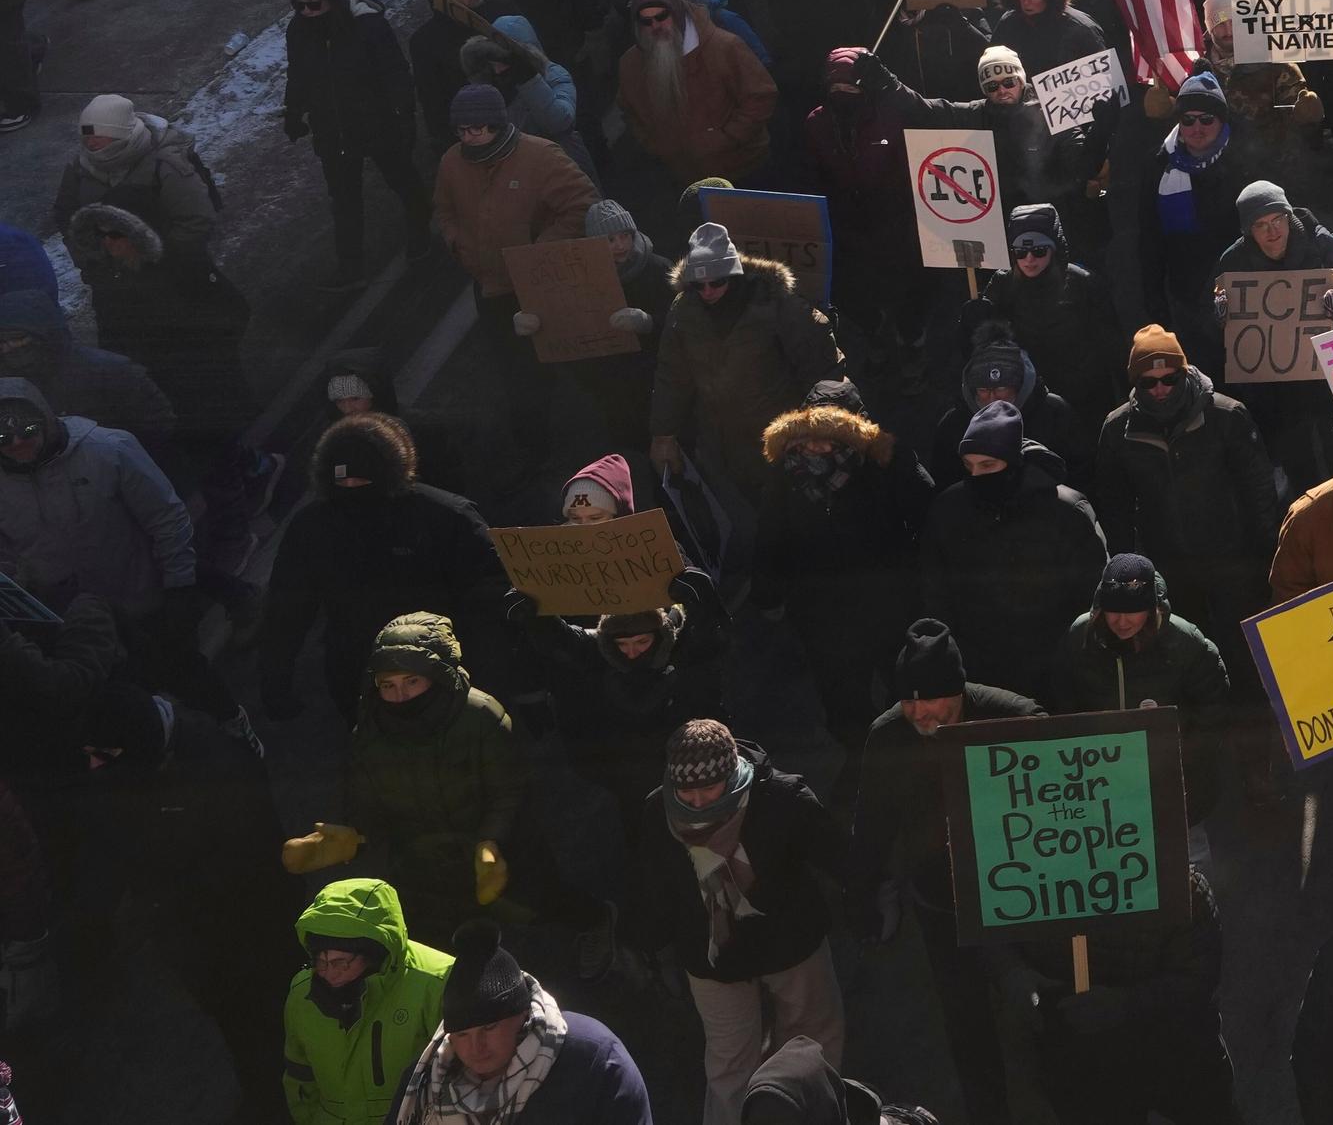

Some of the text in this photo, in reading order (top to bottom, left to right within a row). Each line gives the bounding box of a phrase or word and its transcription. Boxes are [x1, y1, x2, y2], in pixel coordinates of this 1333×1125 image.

[988, 741, 1122, 780] Do you
[1009, 775, 1111, 808] Hear
[1048, 802, 1086, 822] the
[1001, 811, 1141, 869] People
[988, 853, 1149, 921] Sing?
